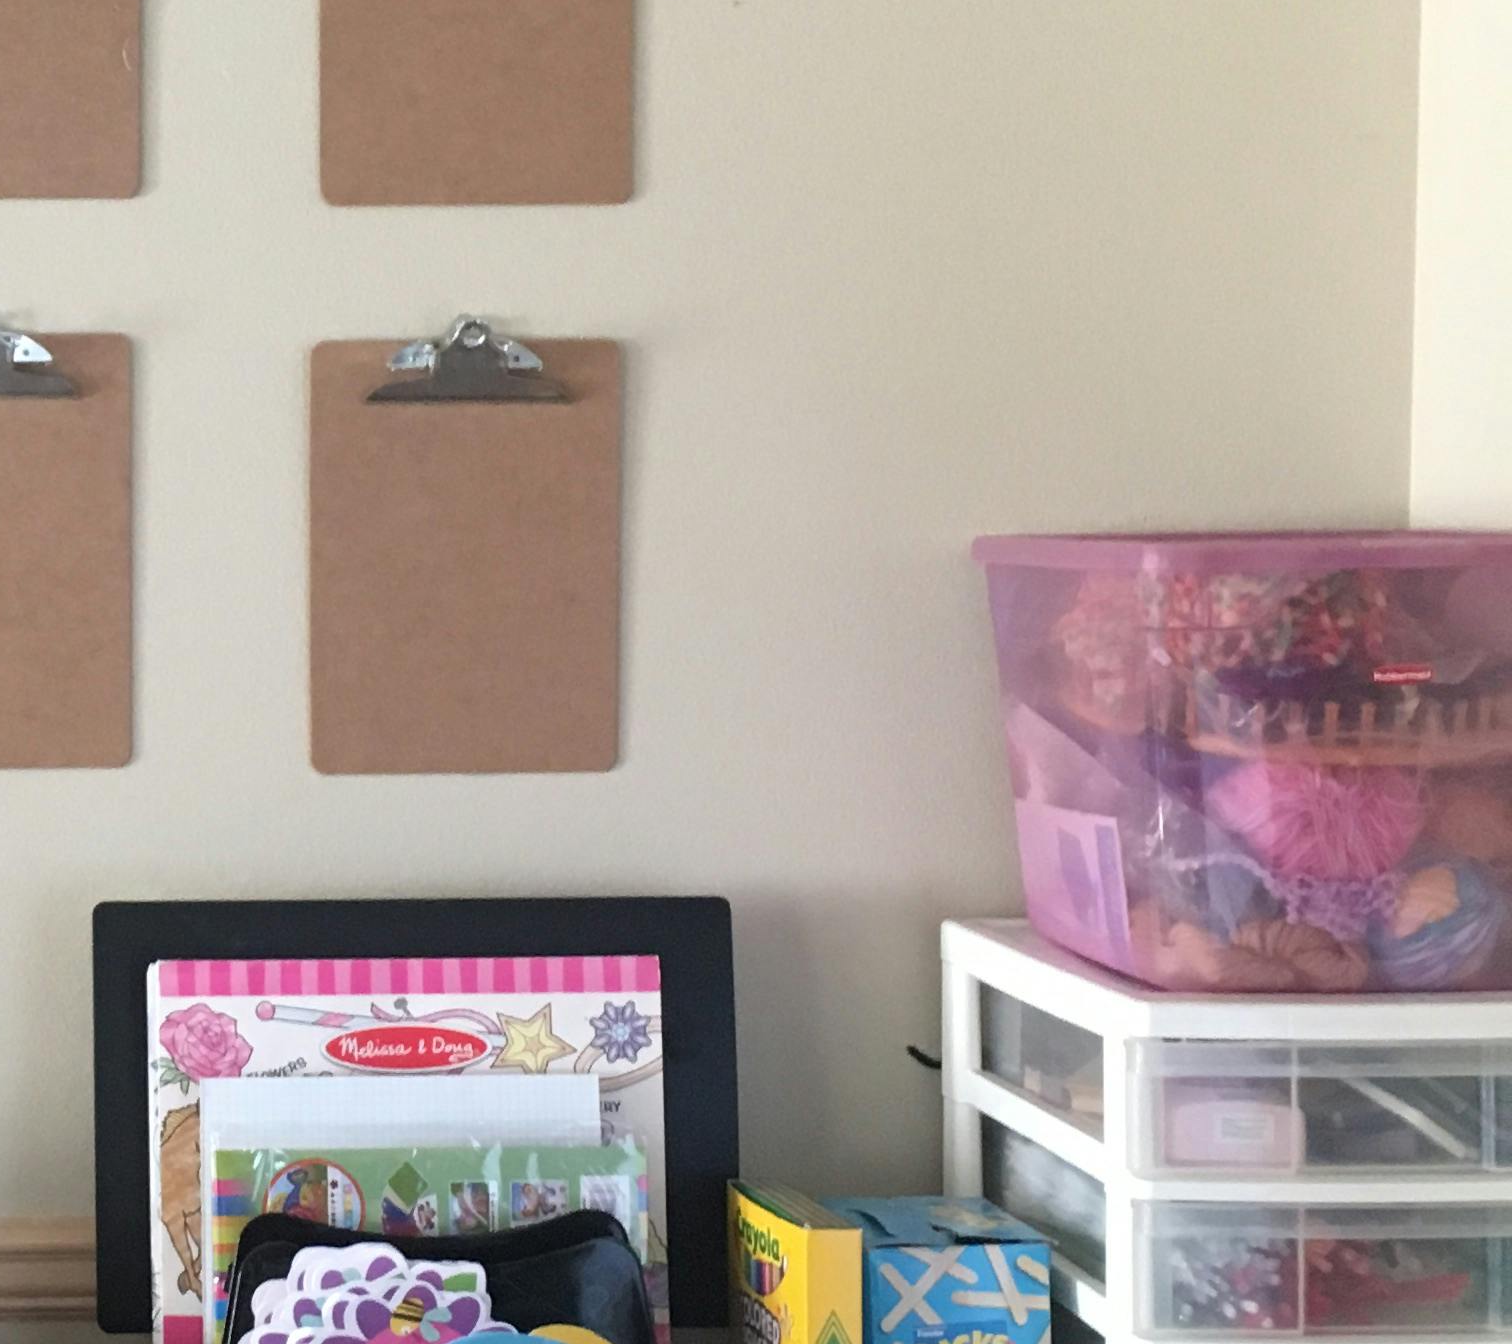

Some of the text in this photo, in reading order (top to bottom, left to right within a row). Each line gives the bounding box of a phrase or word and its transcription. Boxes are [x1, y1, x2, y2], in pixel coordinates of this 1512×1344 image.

[339, 1037, 413, 1062] Melissa
[432, 1036, 474, 1063] Doug
[736, 1205, 780, 1262] Crayola
